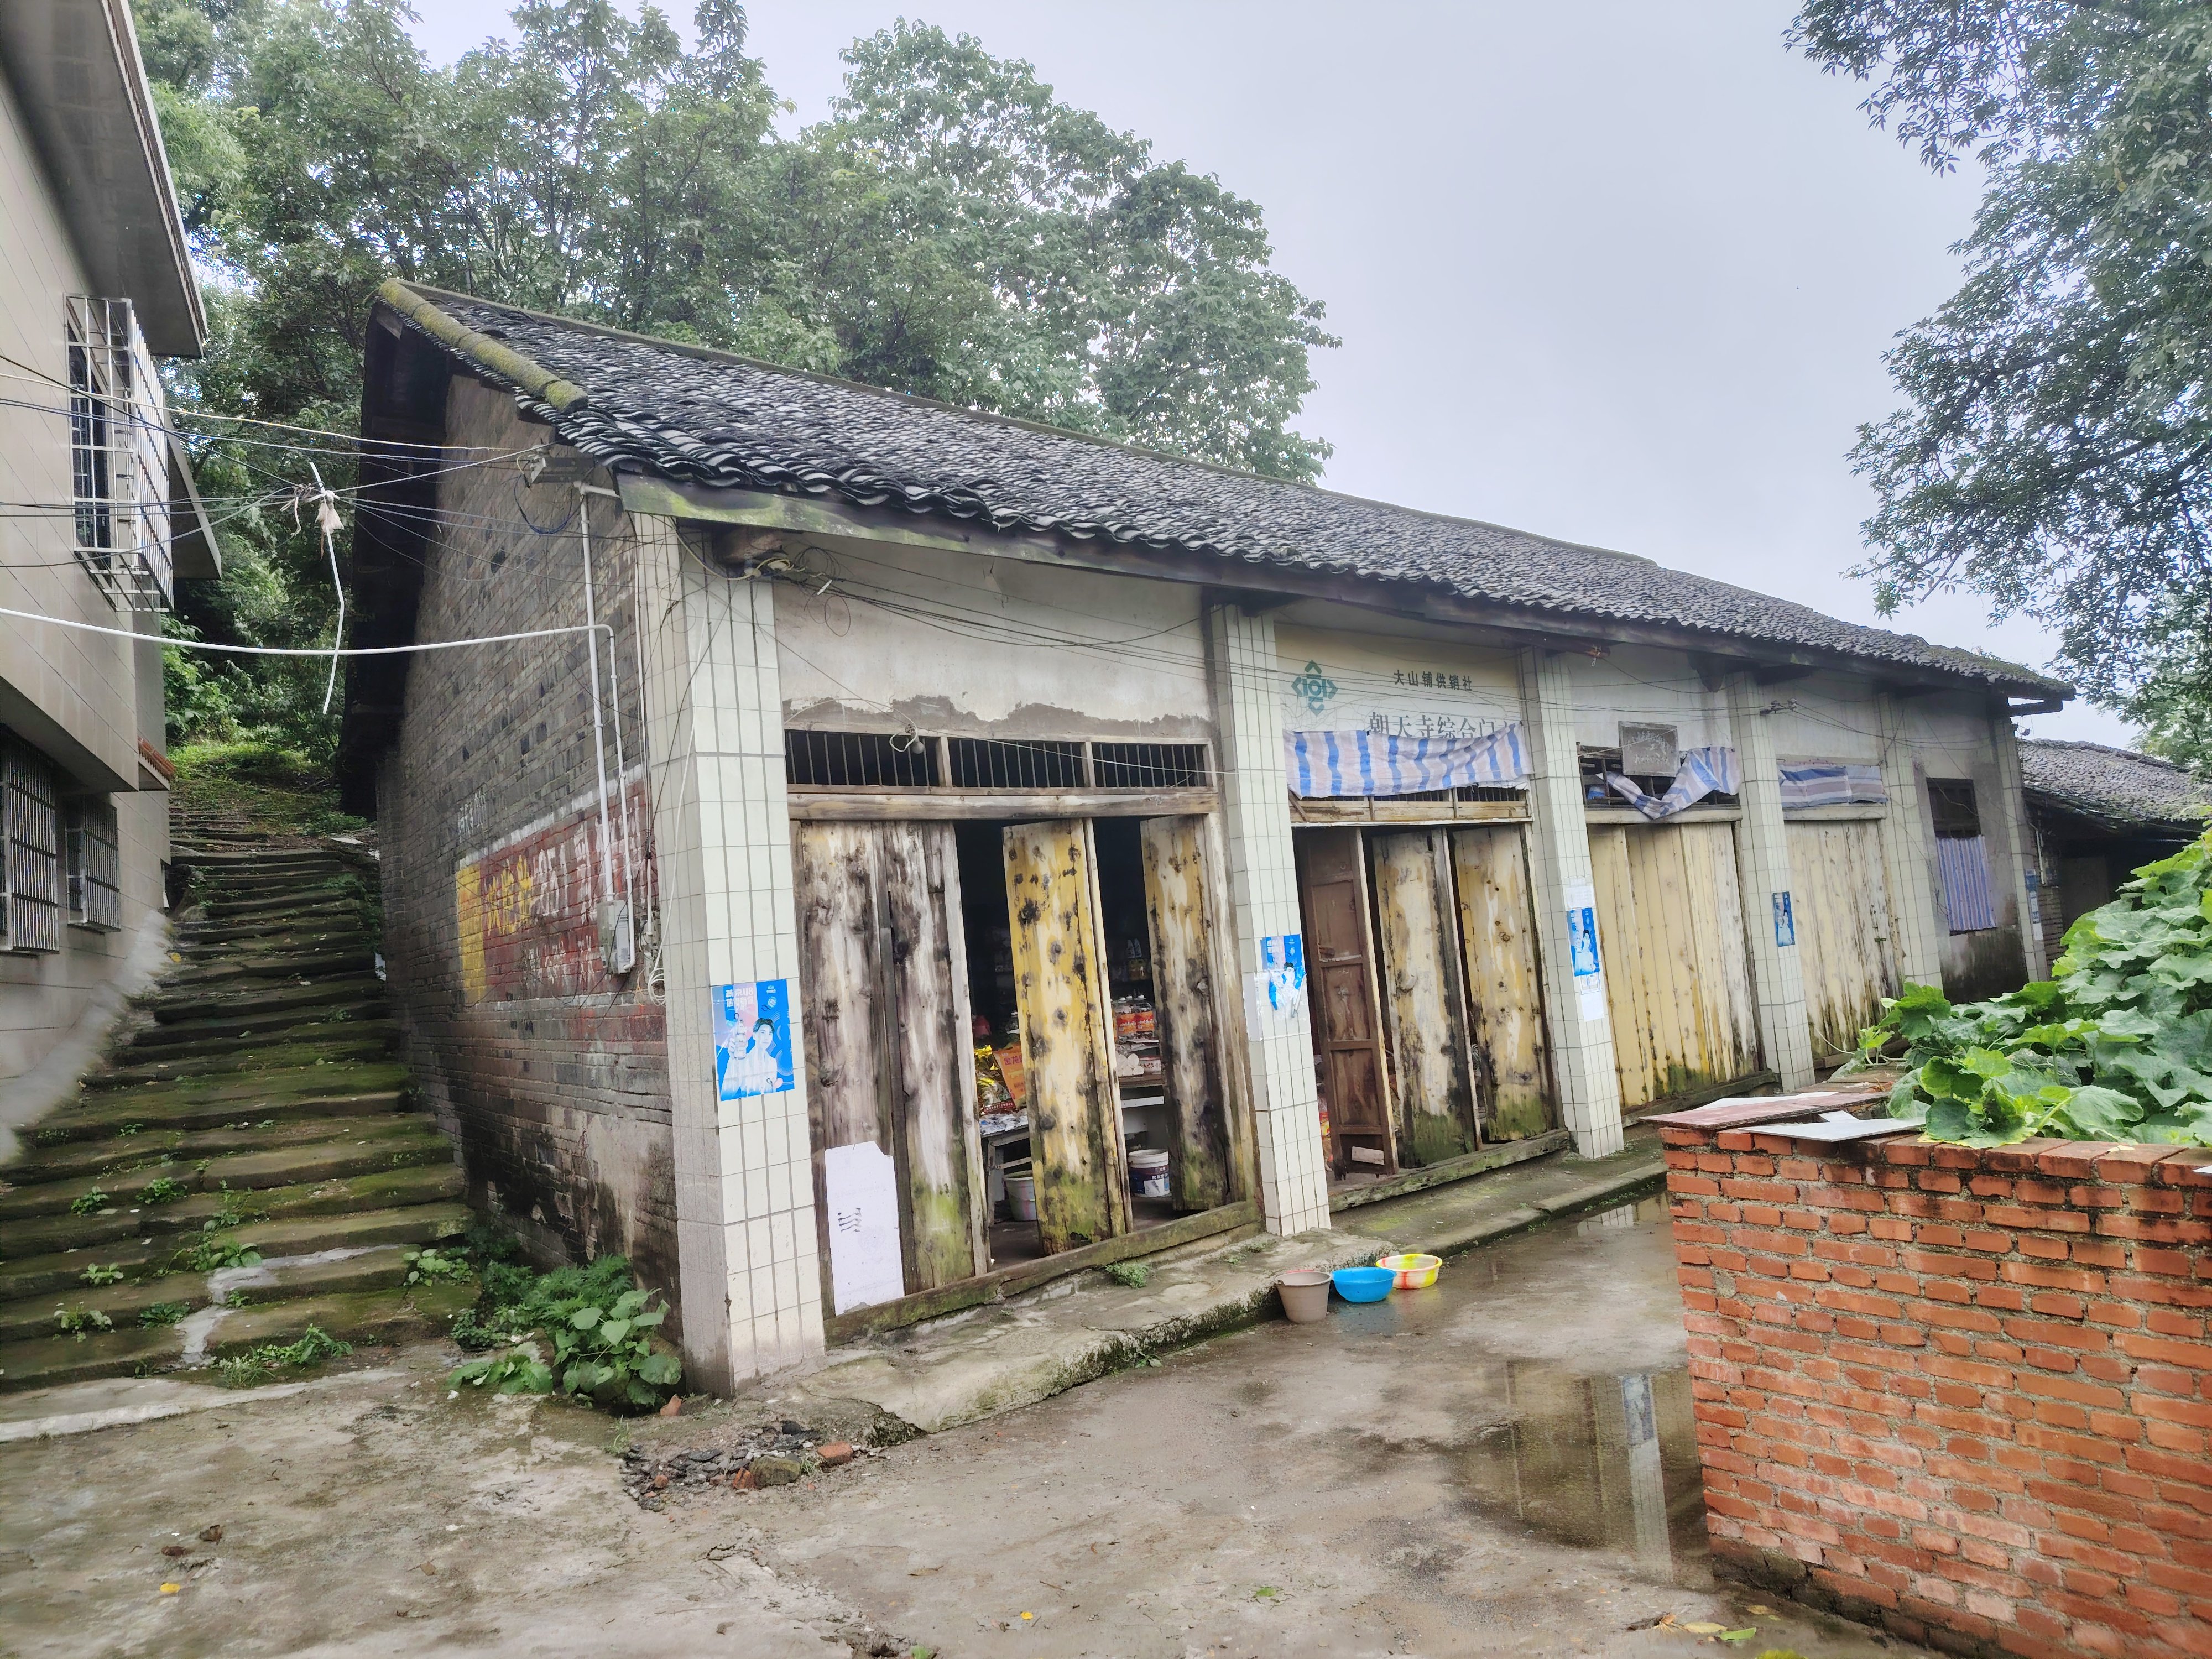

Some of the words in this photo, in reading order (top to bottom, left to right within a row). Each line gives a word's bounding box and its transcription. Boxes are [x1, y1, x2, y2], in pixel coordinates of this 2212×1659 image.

[1394, 669, 1472, 691] 大山铺供销社
[1368, 711, 1508, 739] 朝天寺综合门
